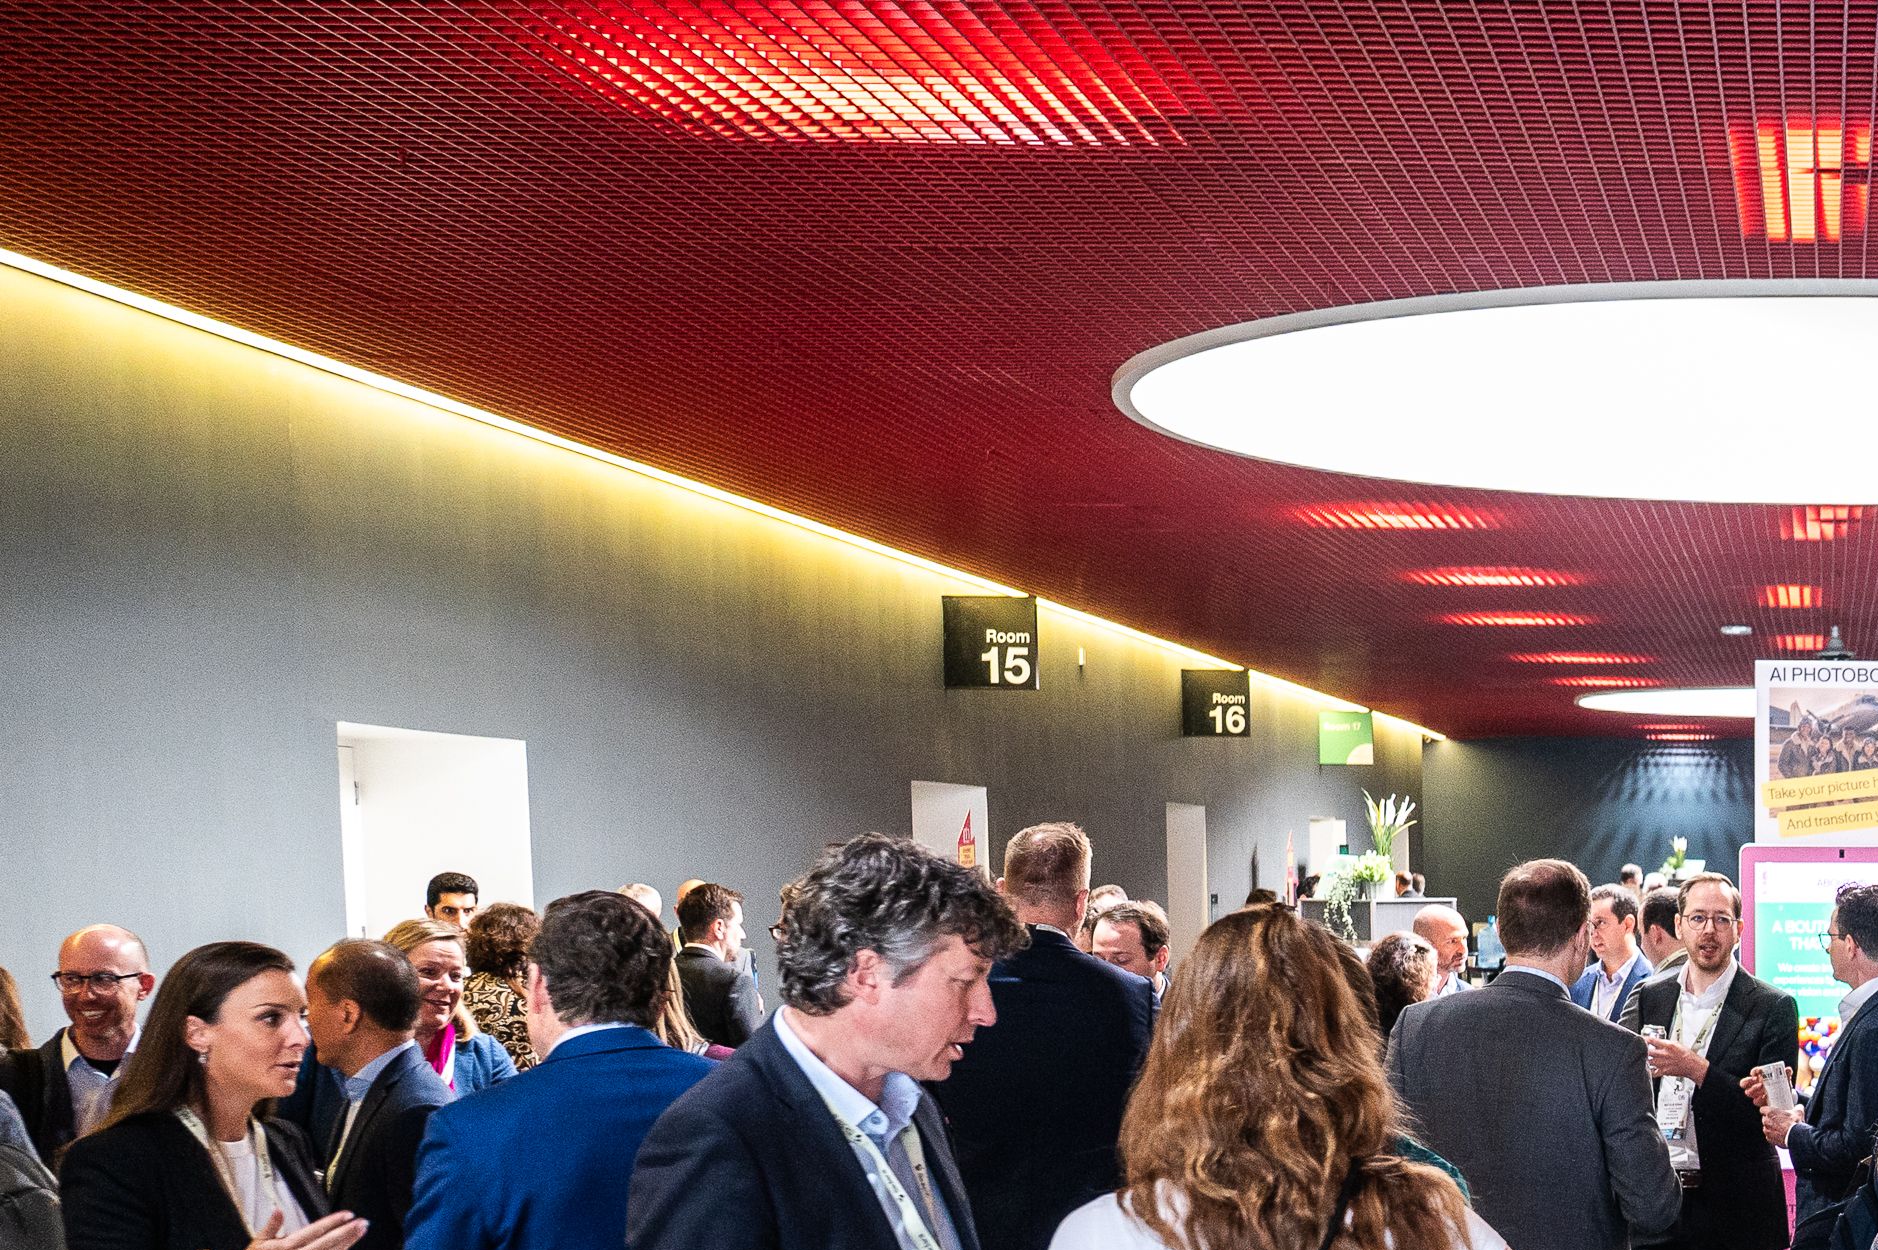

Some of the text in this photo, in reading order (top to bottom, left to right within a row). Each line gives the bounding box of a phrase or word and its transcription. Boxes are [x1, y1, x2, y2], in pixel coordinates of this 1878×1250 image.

[986, 629, 1030, 643] Room
[982, 647, 1030, 684] 15
[1770, 667, 1786, 682] AI
[1212, 693, 1245, 704] Room
[1209, 705, 1245, 733] 16
[1768, 787, 1796, 800] Take
[1800, 784, 1824, 797] your
[1828, 780, 1869, 795] picture
[1787, 816, 1812, 830] And
[1815, 811, 1873, 827] transform
